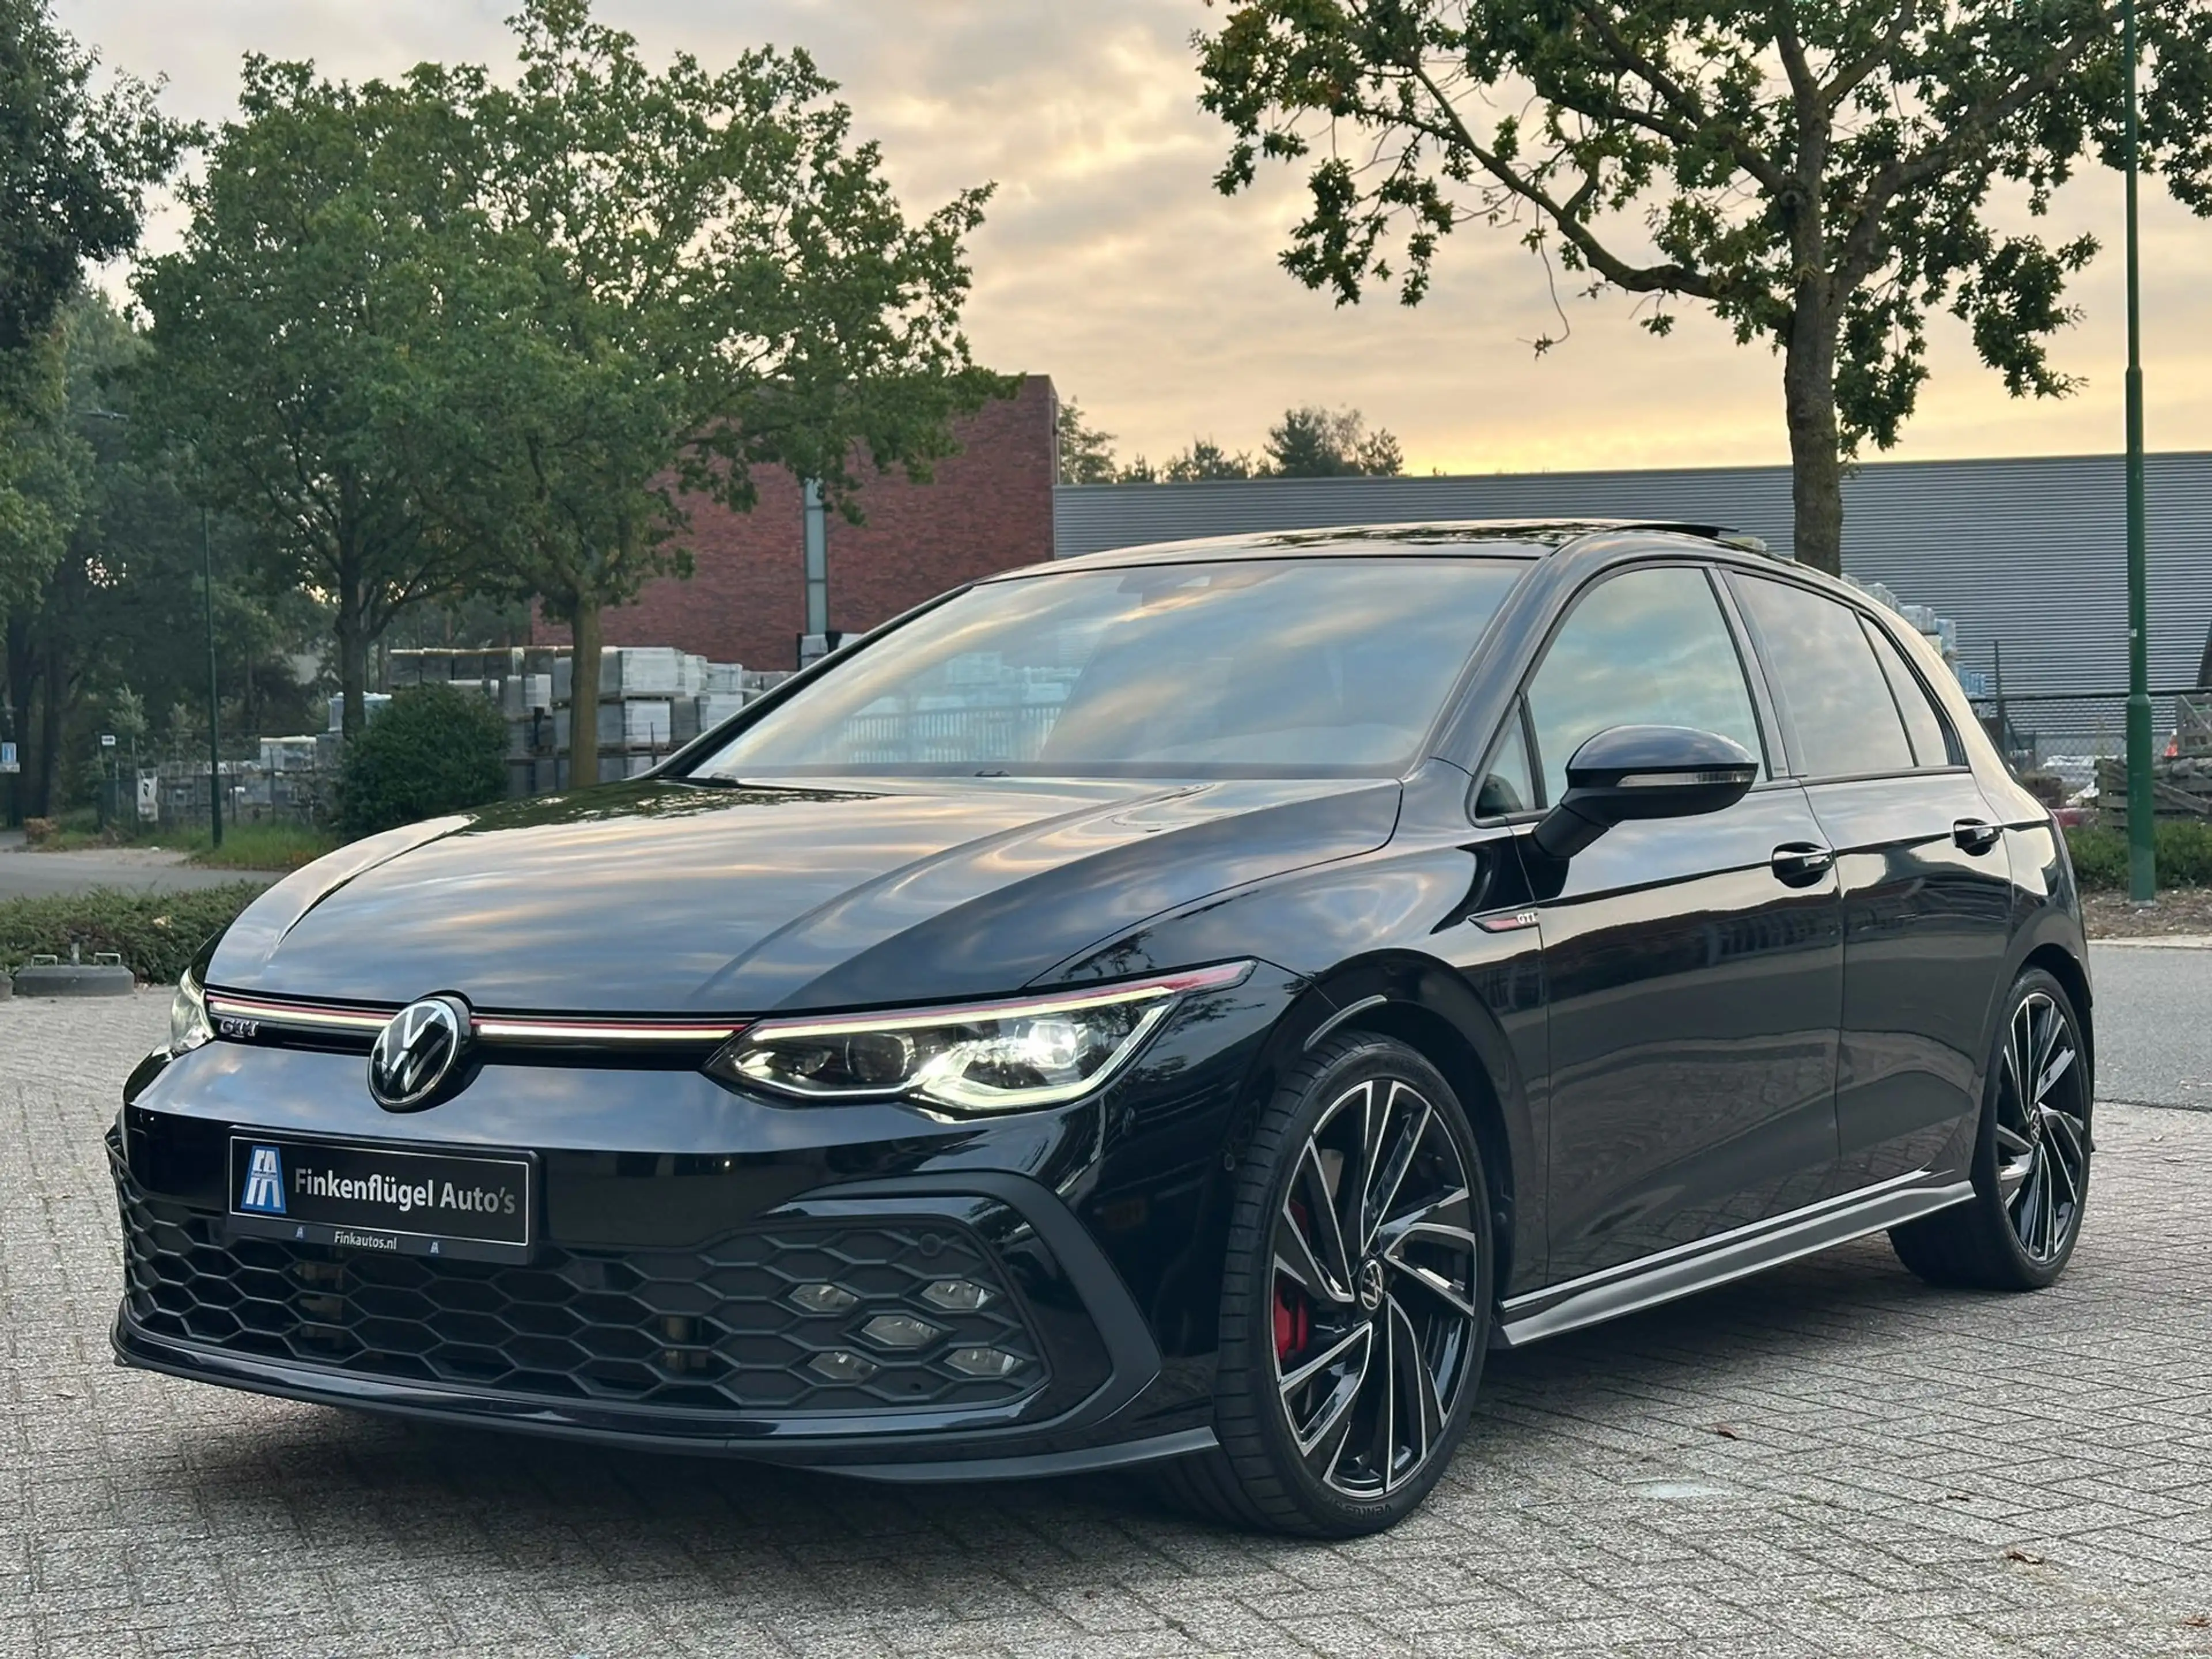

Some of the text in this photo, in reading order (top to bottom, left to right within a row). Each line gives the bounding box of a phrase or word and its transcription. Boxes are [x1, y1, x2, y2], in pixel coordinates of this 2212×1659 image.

[1517, 912, 1537, 924] GTI
[220, 1018, 259, 1037] GTI
[295, 1168, 516, 1215] Finkenflügel Auto's
[334, 1231, 397, 1251] Finkautos.nl
